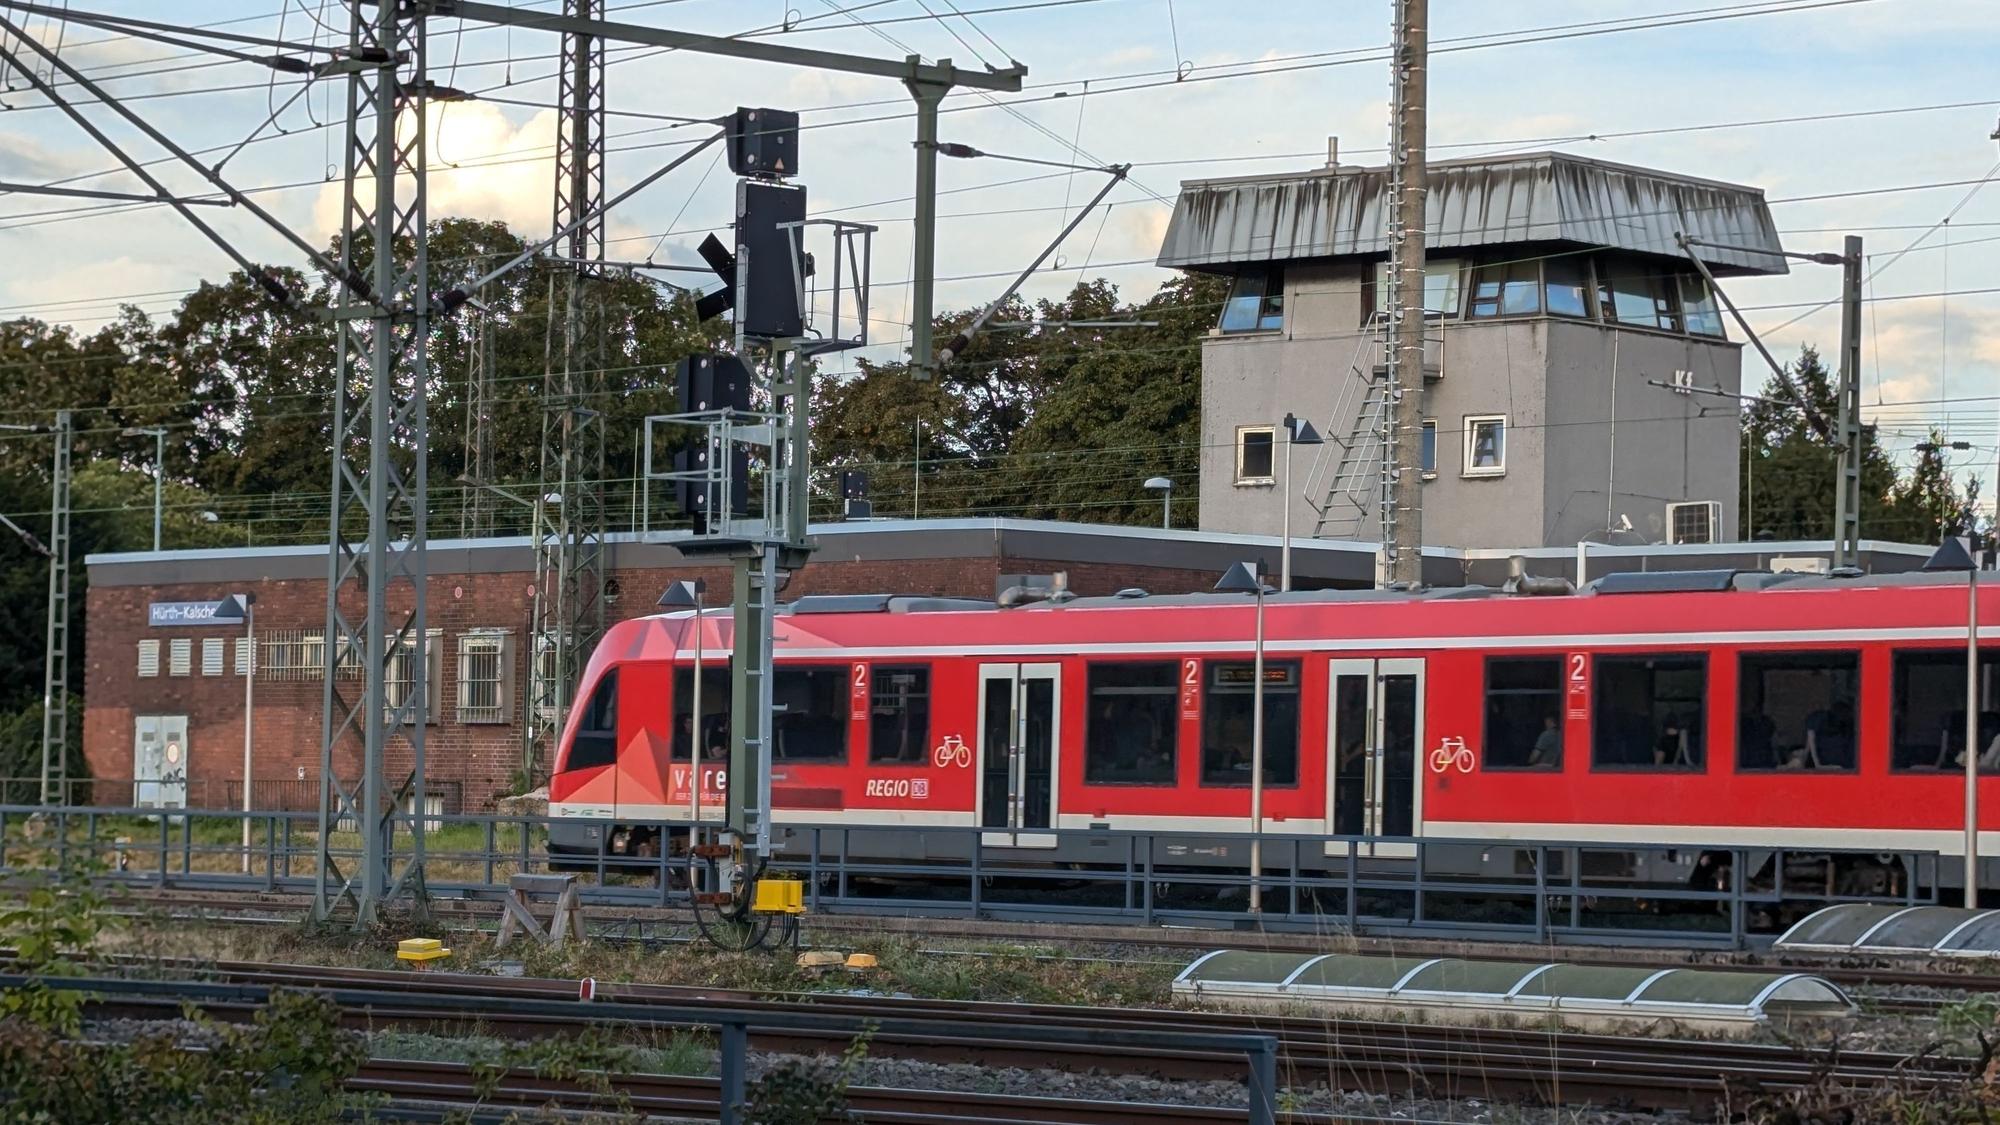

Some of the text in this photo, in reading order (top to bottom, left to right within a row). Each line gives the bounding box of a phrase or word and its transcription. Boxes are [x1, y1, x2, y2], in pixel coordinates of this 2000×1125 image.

[152, 605, 218, 620] Hürth-Kalsche
[854, 664, 866, 687] 2
[1185, 660, 1198, 684] 2
[1571, 654, 1585, 681] 2
[674, 769, 727, 790] vre
[865, 779, 909, 797] REGIO
